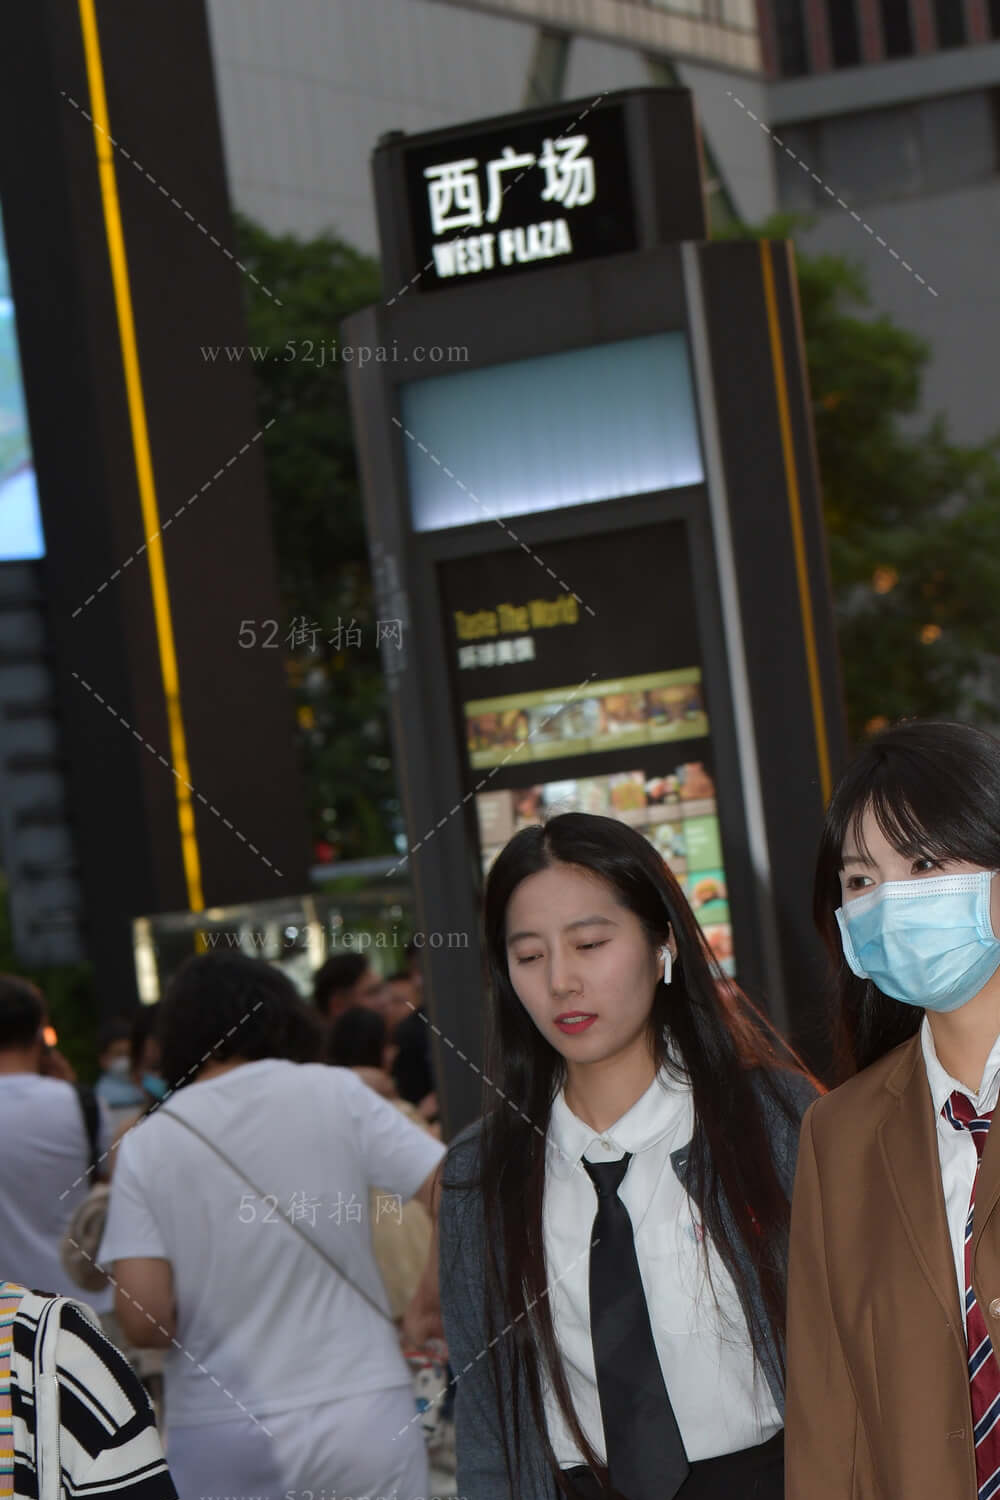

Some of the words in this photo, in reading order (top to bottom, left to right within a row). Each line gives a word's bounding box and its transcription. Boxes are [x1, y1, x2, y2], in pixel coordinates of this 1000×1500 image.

[423, 134, 596, 235] 西广场
[432, 233, 496, 278] WEST
[499, 218, 573, 267] PLAZA
